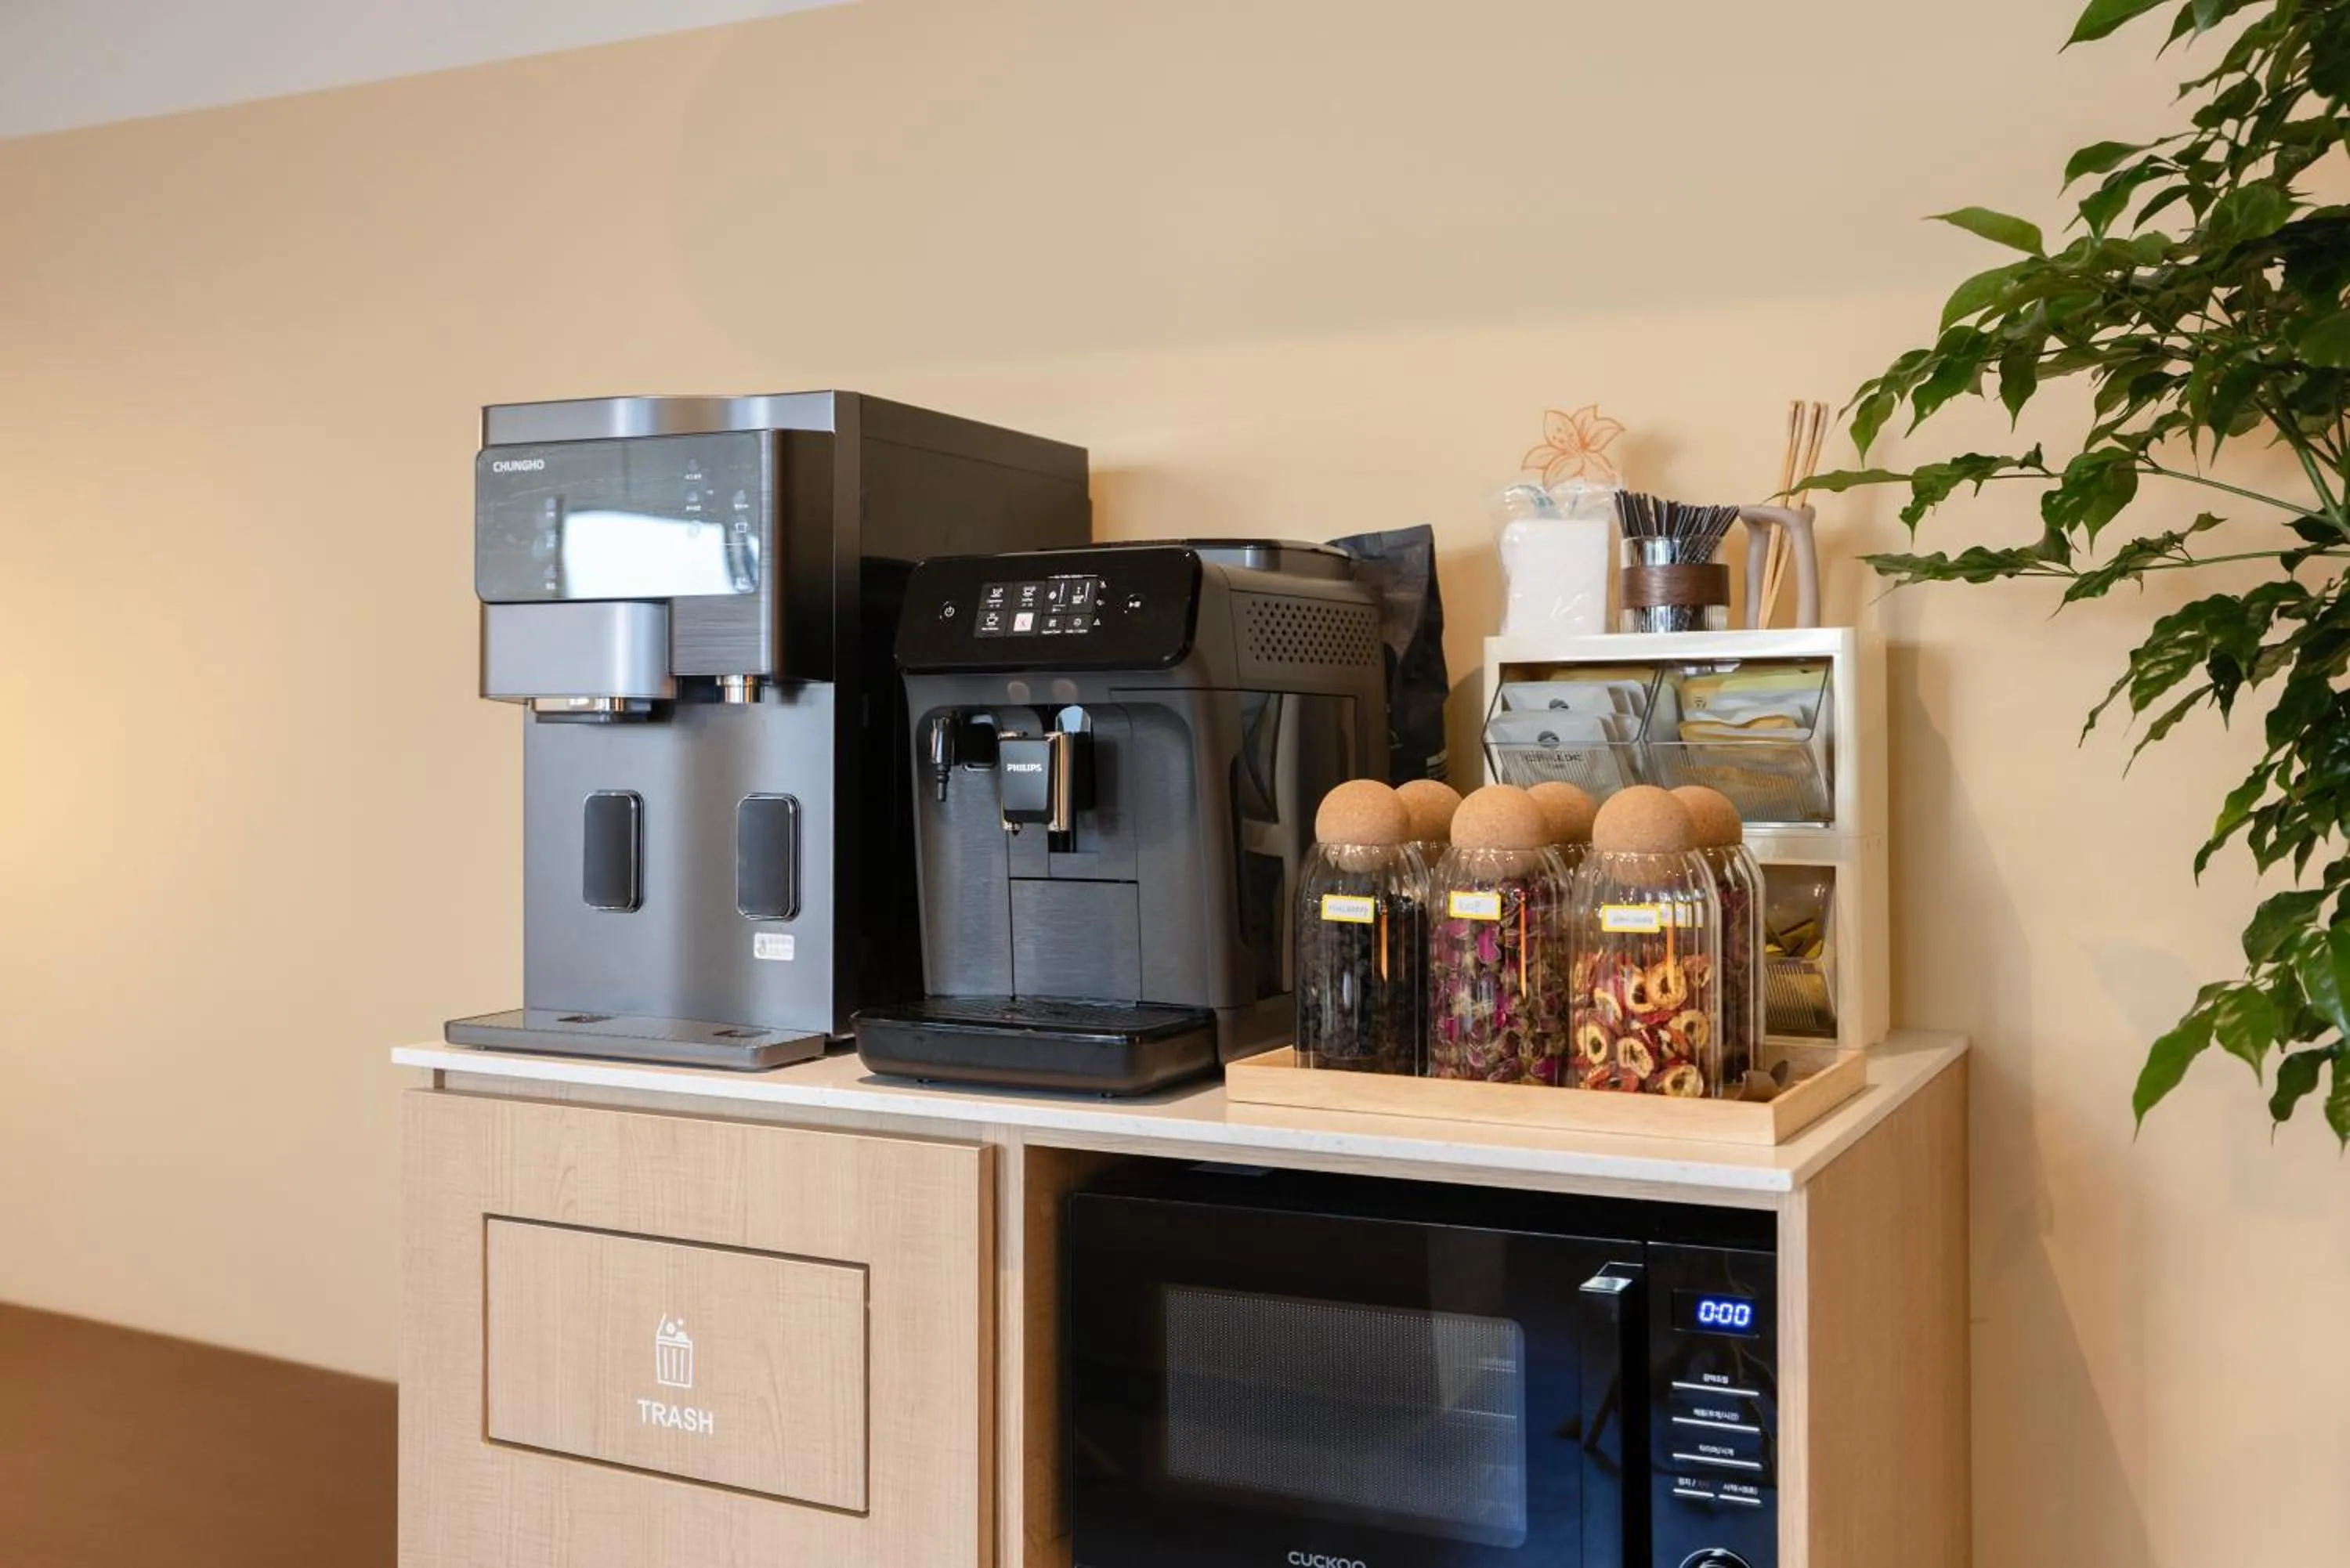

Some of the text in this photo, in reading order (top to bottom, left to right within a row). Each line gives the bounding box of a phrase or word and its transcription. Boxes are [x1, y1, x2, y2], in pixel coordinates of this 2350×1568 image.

[493, 459, 545, 473] CHUNGHO
[1007, 764, 1043, 772] PHILIPS
[1698, 1301, 1751, 1326] 0:00
[637, 1399, 714, 1436] TRASH
